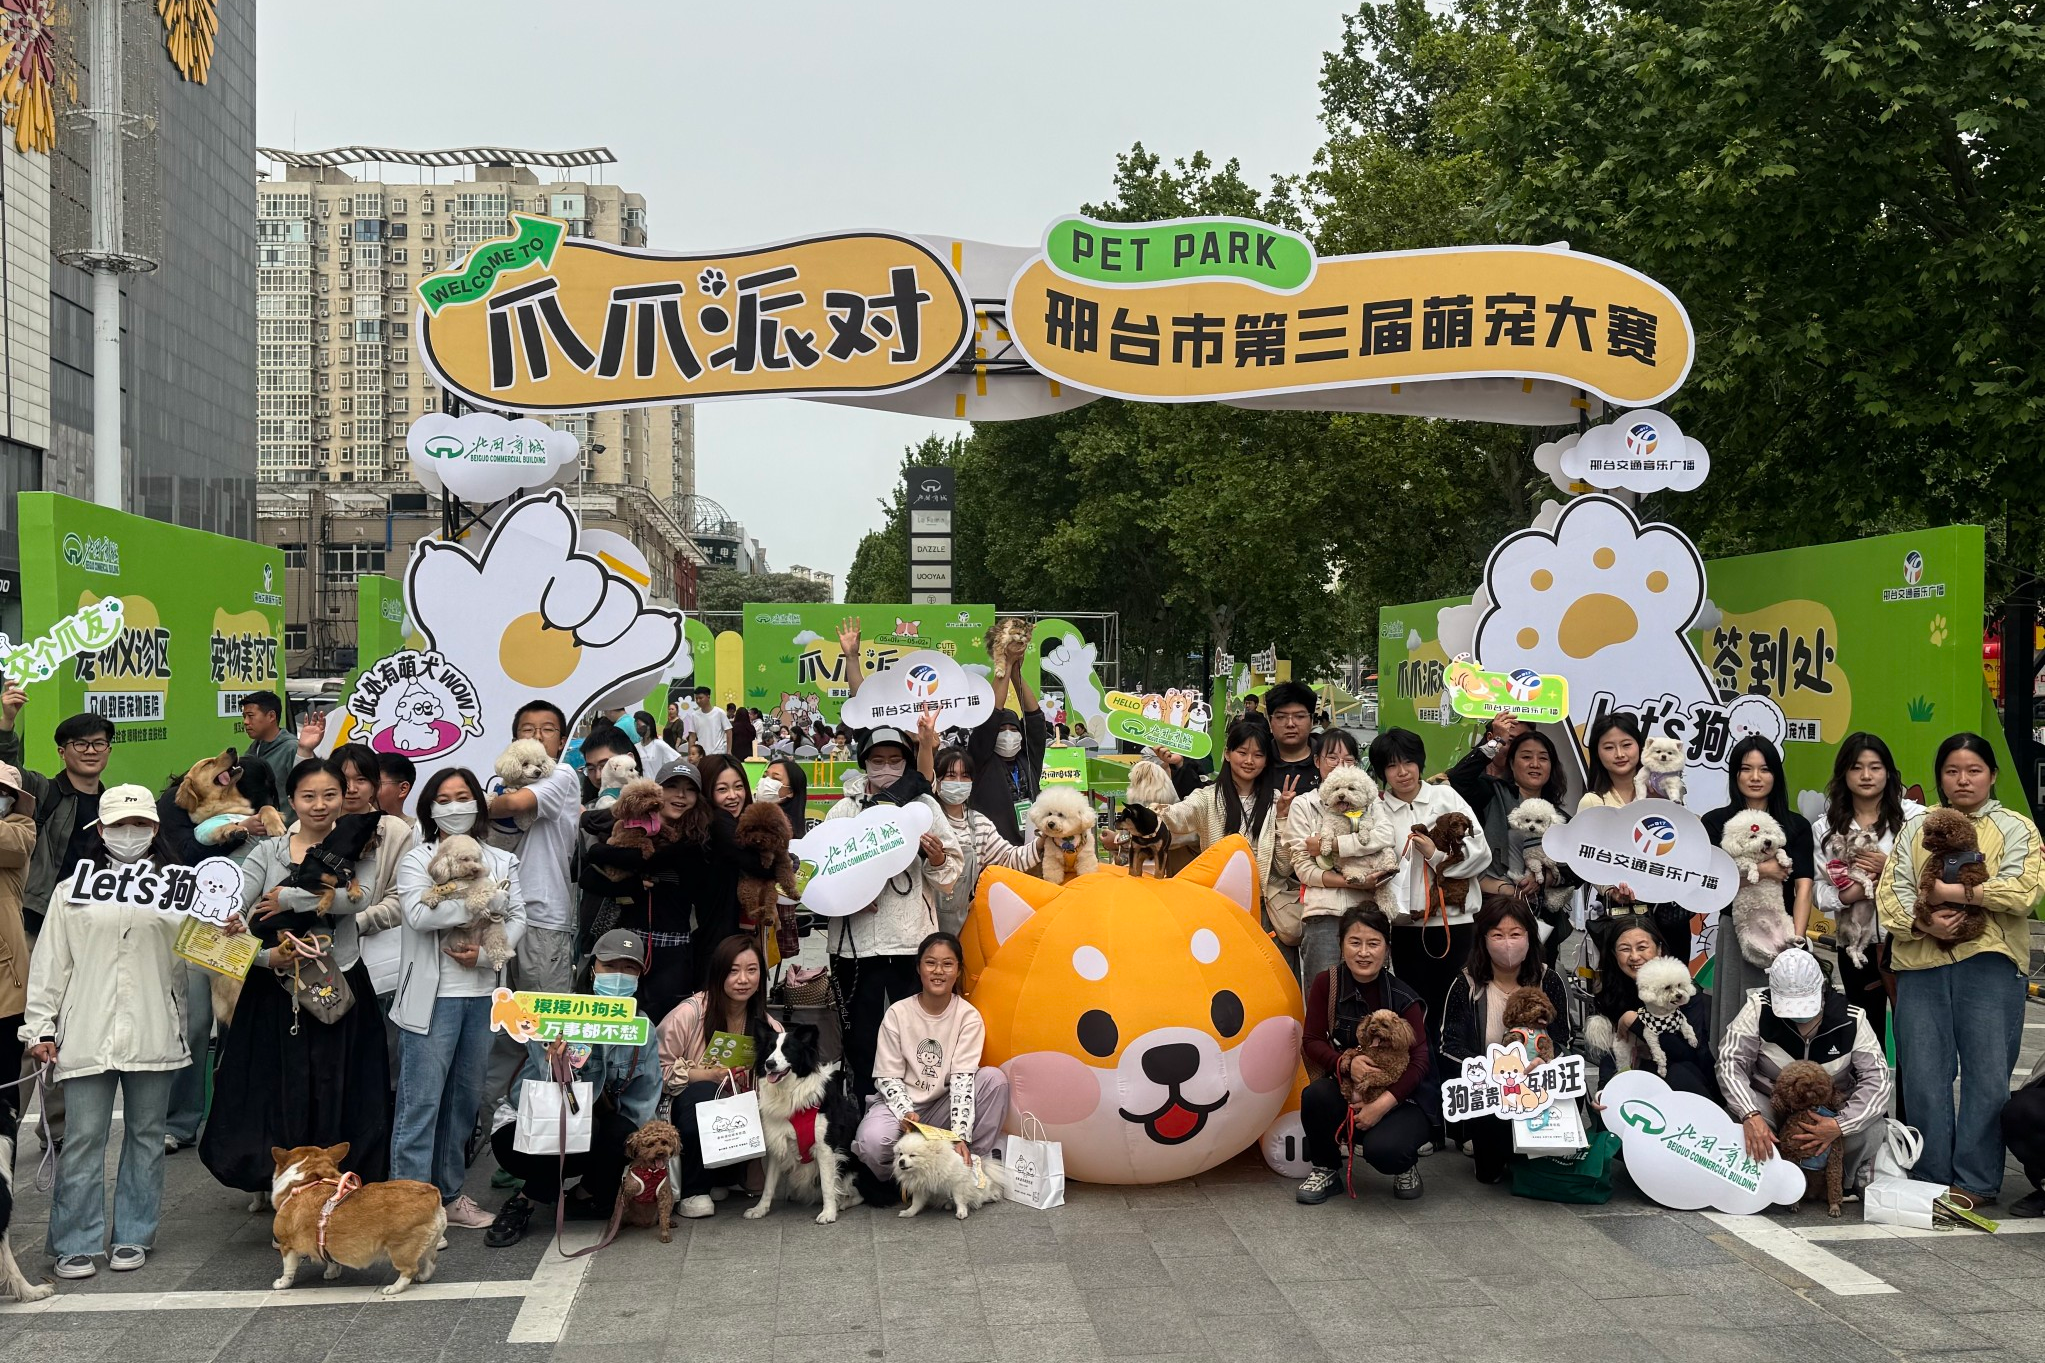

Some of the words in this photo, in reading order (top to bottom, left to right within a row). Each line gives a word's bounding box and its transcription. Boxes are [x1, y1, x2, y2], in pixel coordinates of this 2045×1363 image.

[430, 248, 516, 304] WELCOME
[519, 237, 544, 258] TO
[1072, 229, 1151, 273] PET
[1173, 231, 1278, 271] PARK
[488, 266, 931, 387] 爪爪派对
[1045, 287, 1659, 369] 邢台市第三届萌宠大赛
[490, 455, 522, 463] COMMERCIAL
[523, 456, 546, 464] BUILDING
[1590, 459, 1695, 471] 邢台交通音乐广播
[917, 545, 946, 553] DAZZLE
[4, 608, 121, 689] 交个爪友
[211, 630, 279, 683] 宠物美容区
[1713, 626, 1835, 702] 签到处
[352, 654, 439, 718] 此处有萌犬
[438, 668, 475, 710] WOW
[1113, 696, 1141, 710] HELLO
[847, 847, 881, 867] COMMERCIAL
[880, 837, 905, 853] BUILDING
[1579, 844, 1720, 890] 邢台交通音乐广播
[533, 998, 628, 1018] 摸摸小狗头
[543, 1020, 640, 1041] 万事都不愁
[1446, 1084, 1500, 1117] 狗富贵
[1527, 1060, 1582, 1093] 互相汪
[1666, 1139, 1691, 1158] BEIGUO
[1689, 1151, 1728, 1178] COMMERCIAL
[1727, 1171, 1758, 1192] BUILDING
